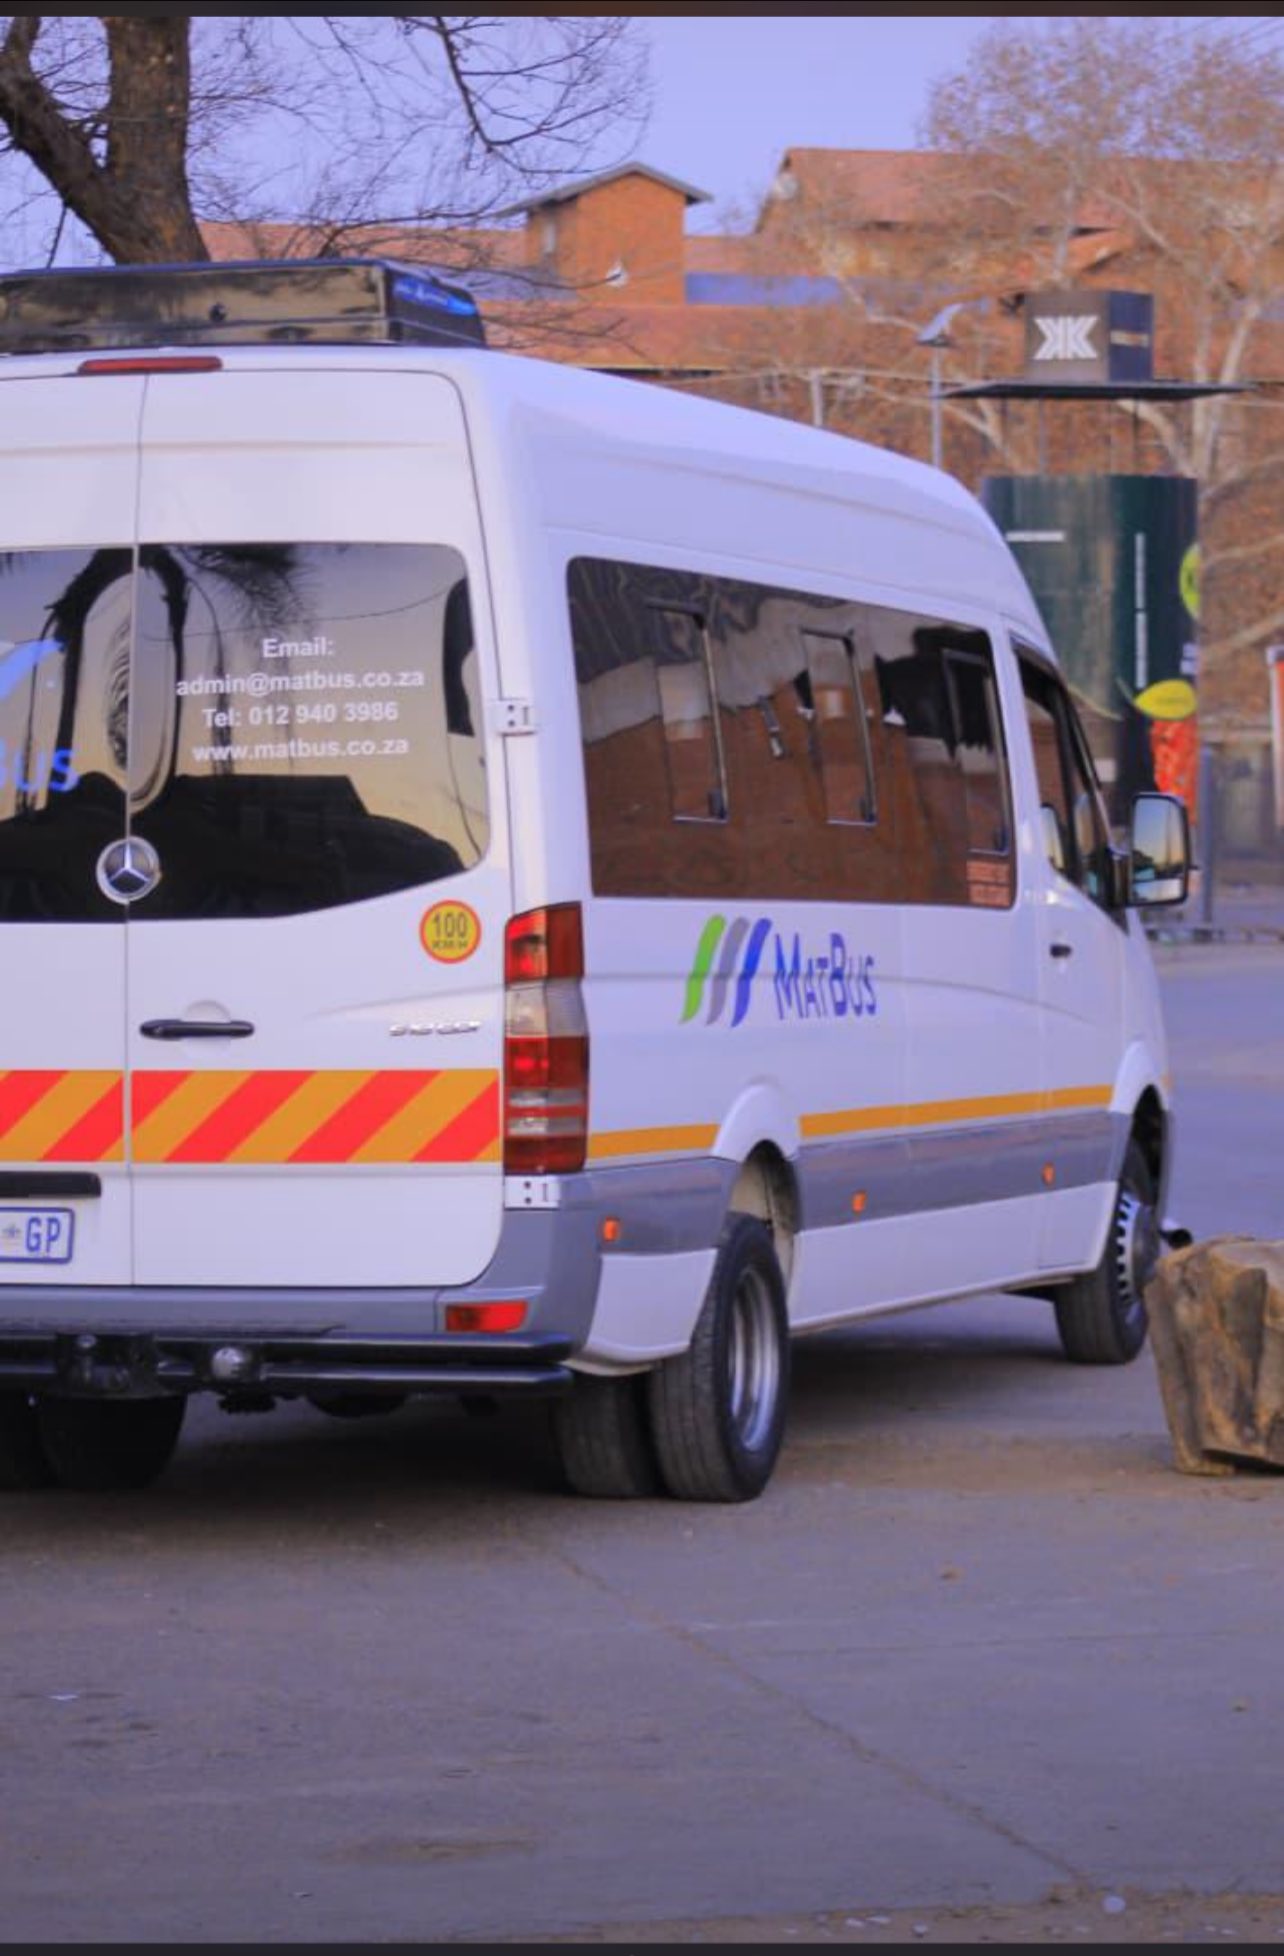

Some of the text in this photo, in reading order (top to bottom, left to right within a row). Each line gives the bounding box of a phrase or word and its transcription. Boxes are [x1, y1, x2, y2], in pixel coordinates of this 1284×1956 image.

[262, 636, 335, 658] Email:
[175, 670, 424, 697] admin@matbus.co.za
[202, 701, 399, 728] Tel: 012 940 3986
[192, 737, 410, 763] www.matbus.co.za
[432, 911, 468, 939] 100
[26, 1217, 61, 1253] GP
